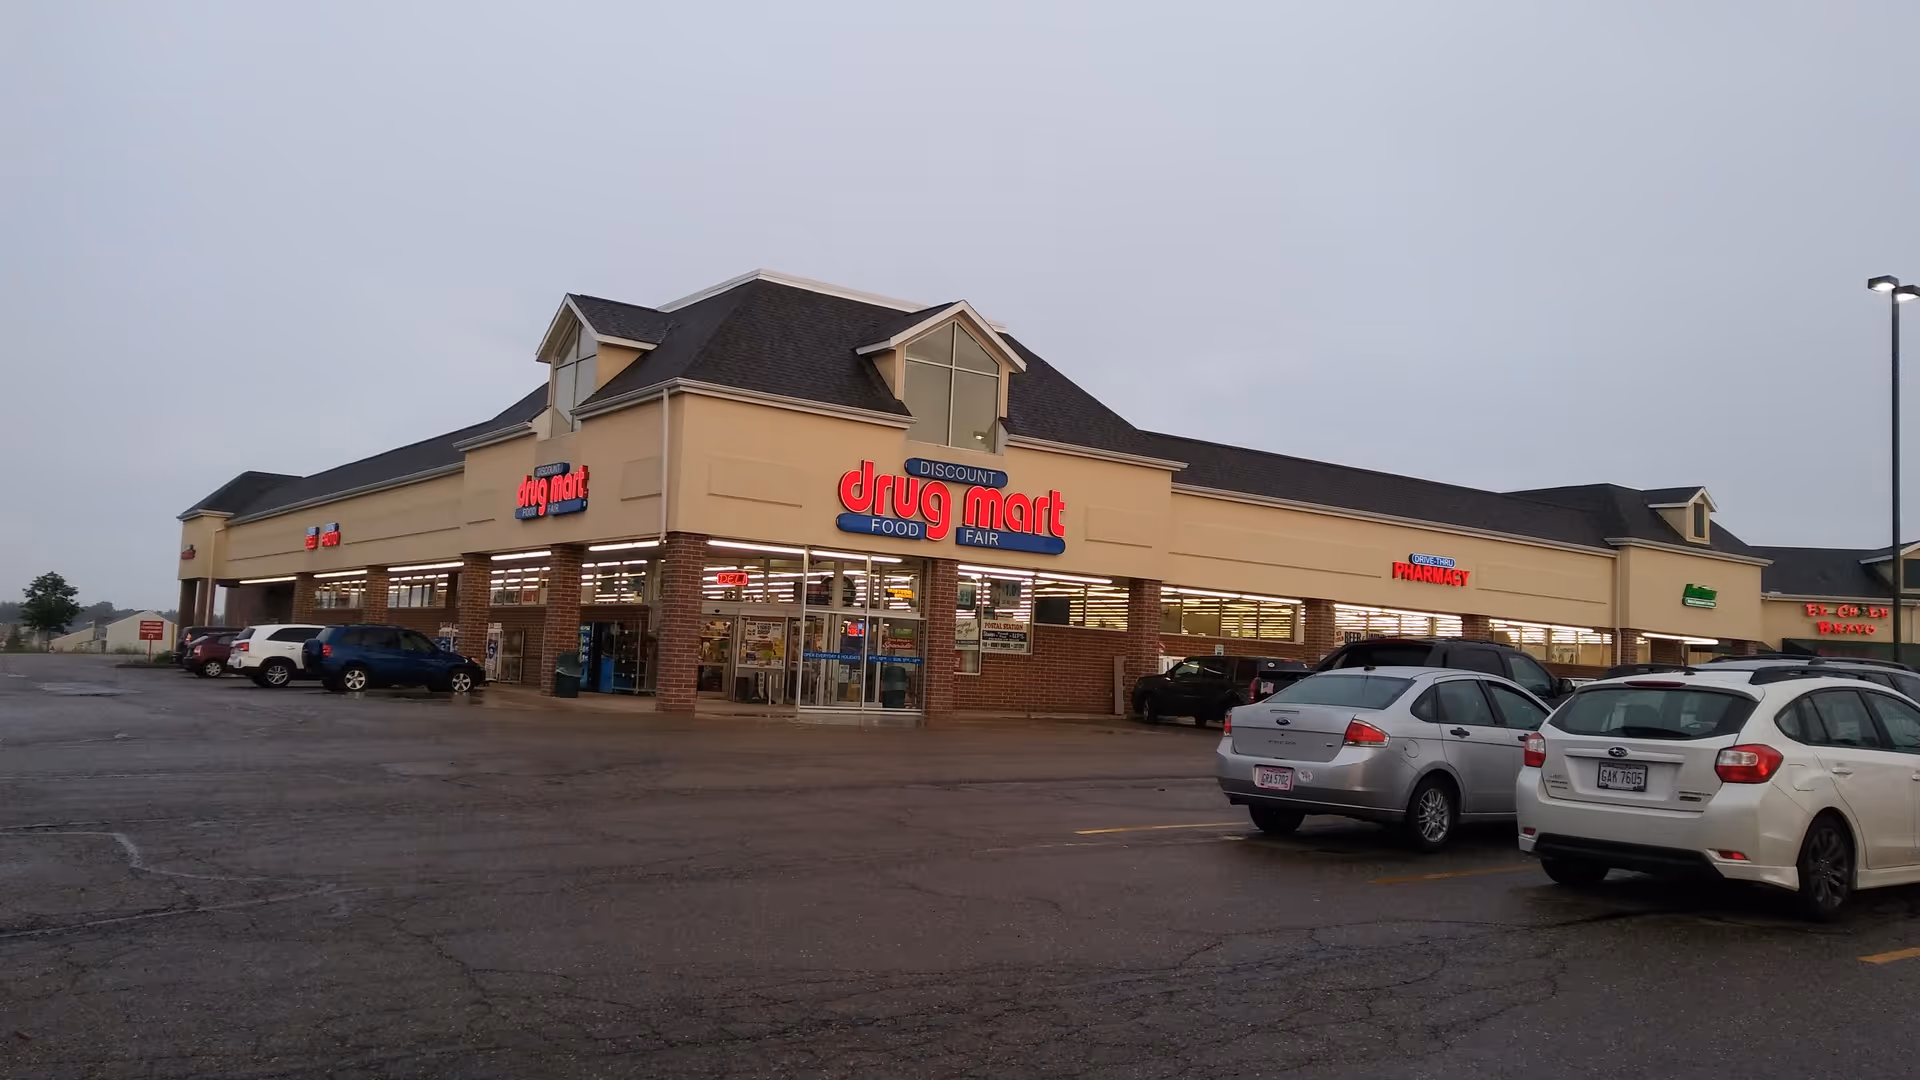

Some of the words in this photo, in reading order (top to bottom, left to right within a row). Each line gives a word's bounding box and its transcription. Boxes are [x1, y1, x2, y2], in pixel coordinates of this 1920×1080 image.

[537, 464, 562, 476] DISCOUNT
[920, 461, 996, 484] DISCOUNT
[517, 475, 547, 516] drug
[550, 465, 587, 503] mart
[839, 460, 952, 541] drug
[963, 486, 1065, 537] mart
[522, 507, 537, 517] FOOD
[547, 503, 559, 513] FAIR
[871, 519, 919, 537] FOOD
[965, 529, 999, 546] FAIR
[1414, 555, 1453, 567] DRIVE-THRU
[719, 574, 746, 584] DELI
[1393, 561, 1471, 587] PHARMACY
[1806, 603, 1828, 617] EL
[984, 622, 1002, 630] POSTAL
[1003, 623, 1024, 631] STATION
[1817, 621, 1877, 635] BRAVO
[1345, 631, 1361, 643] BEER
[1262, 773, 1273, 784] GRA
[1274, 774, 1289, 786] 5702
[1601, 769, 1618, 784] GAK
[1620, 770, 1643, 785] 7605
